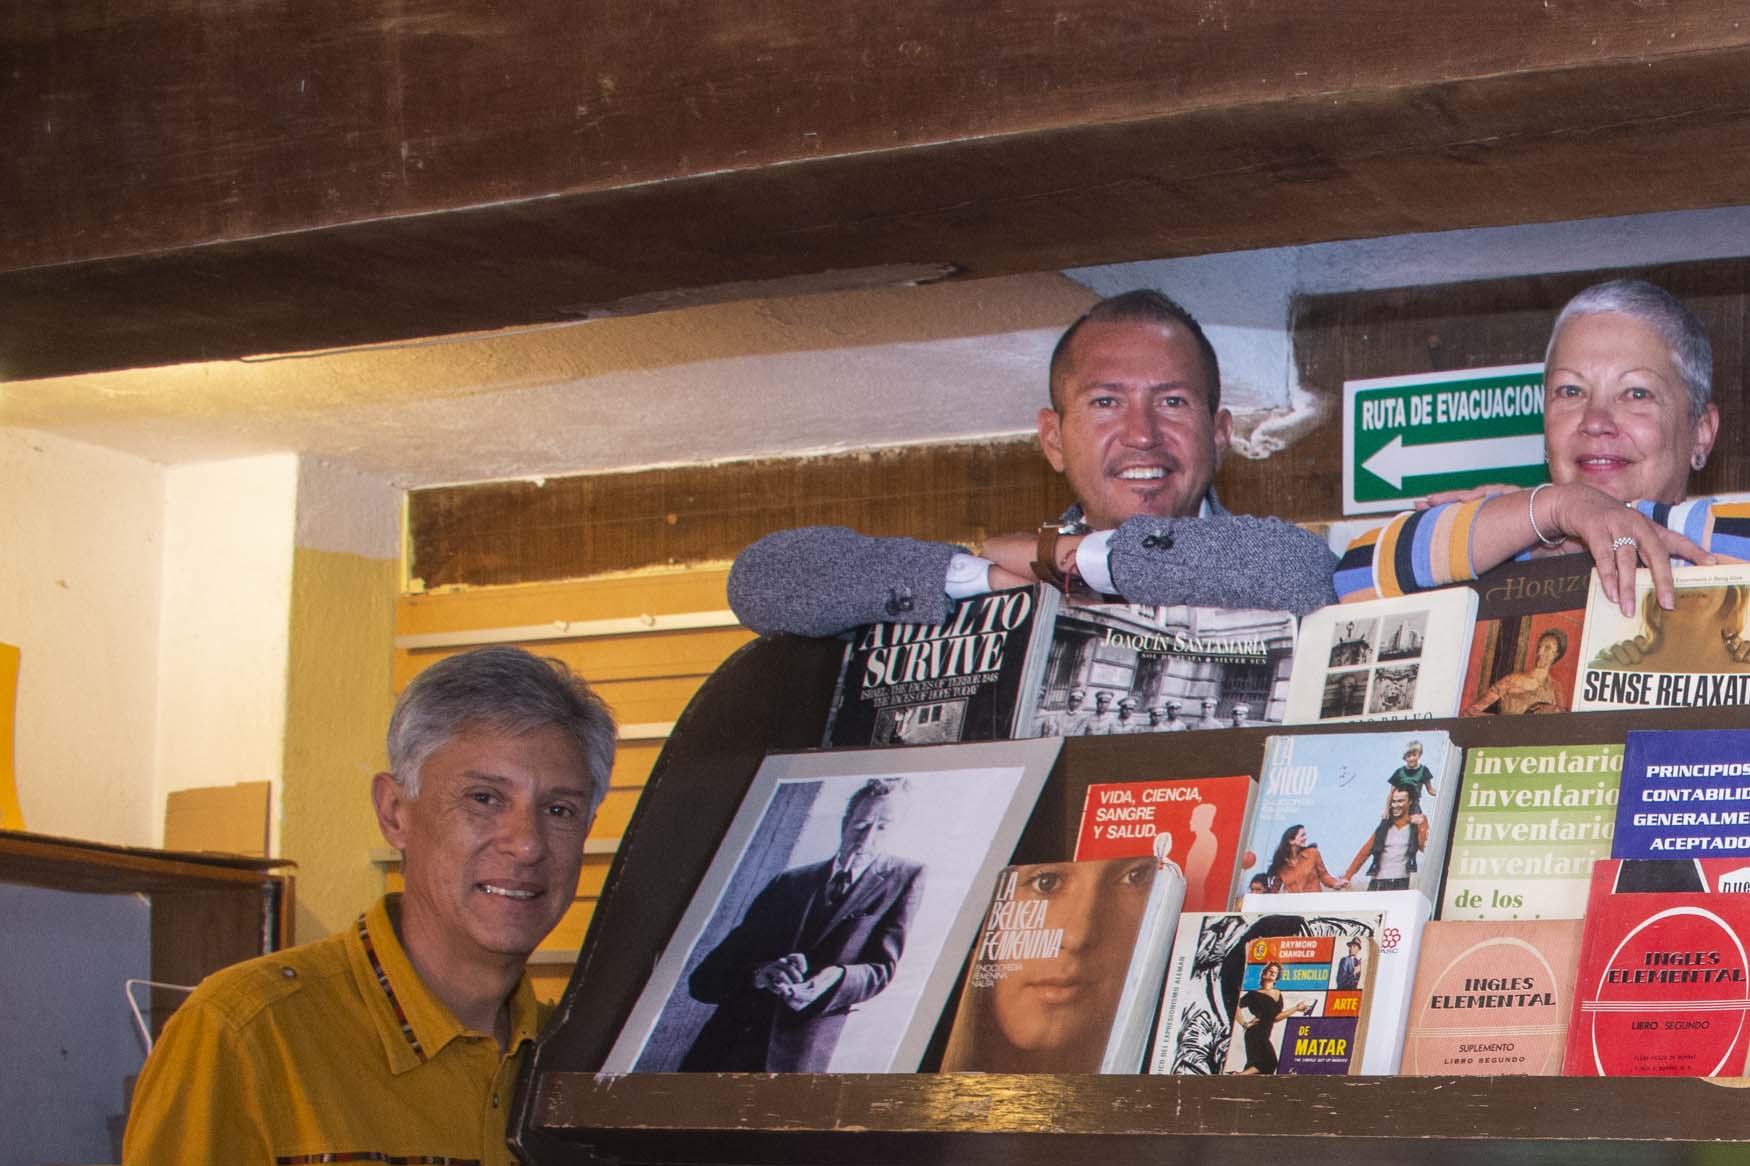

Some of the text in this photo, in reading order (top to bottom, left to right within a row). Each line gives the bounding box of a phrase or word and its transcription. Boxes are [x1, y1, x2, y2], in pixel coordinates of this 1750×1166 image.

[1362, 384, 1545, 430] RUTA DE EVACUACION
[1101, 628, 1268, 656] JOAQUÍN SANTAMARÍA
[863, 631, 1008, 688] SURVIVE
[1583, 671, 1654, 704] SENSE
[1100, 787, 1203, 806] VIDA, CIENCIA,
[1096, 807, 1155, 822] SANGRE
[1093, 824, 1158, 839] Y SALUD.
[1455, 889, 1523, 909] de los
[1645, 951, 1720, 966] INGLES
[1608, 968, 1747, 984] ELEMENTAL
[1464, 977, 1535, 992] INGLES
[1333, 998, 1358, 1010] ARTE
[1431, 993, 1556, 1009] ELEMENTAL
[1298, 1026, 1309, 1036] DE
[1631, 1020, 1710, 1031] LIBRO SEGUNDO
[1295, 1039, 1347, 1056] MATAR
[1459, 1042, 1515, 1053] SUPLEMENTO
[1444, 1056, 1526, 1065] LIBRO SEGUNDO
